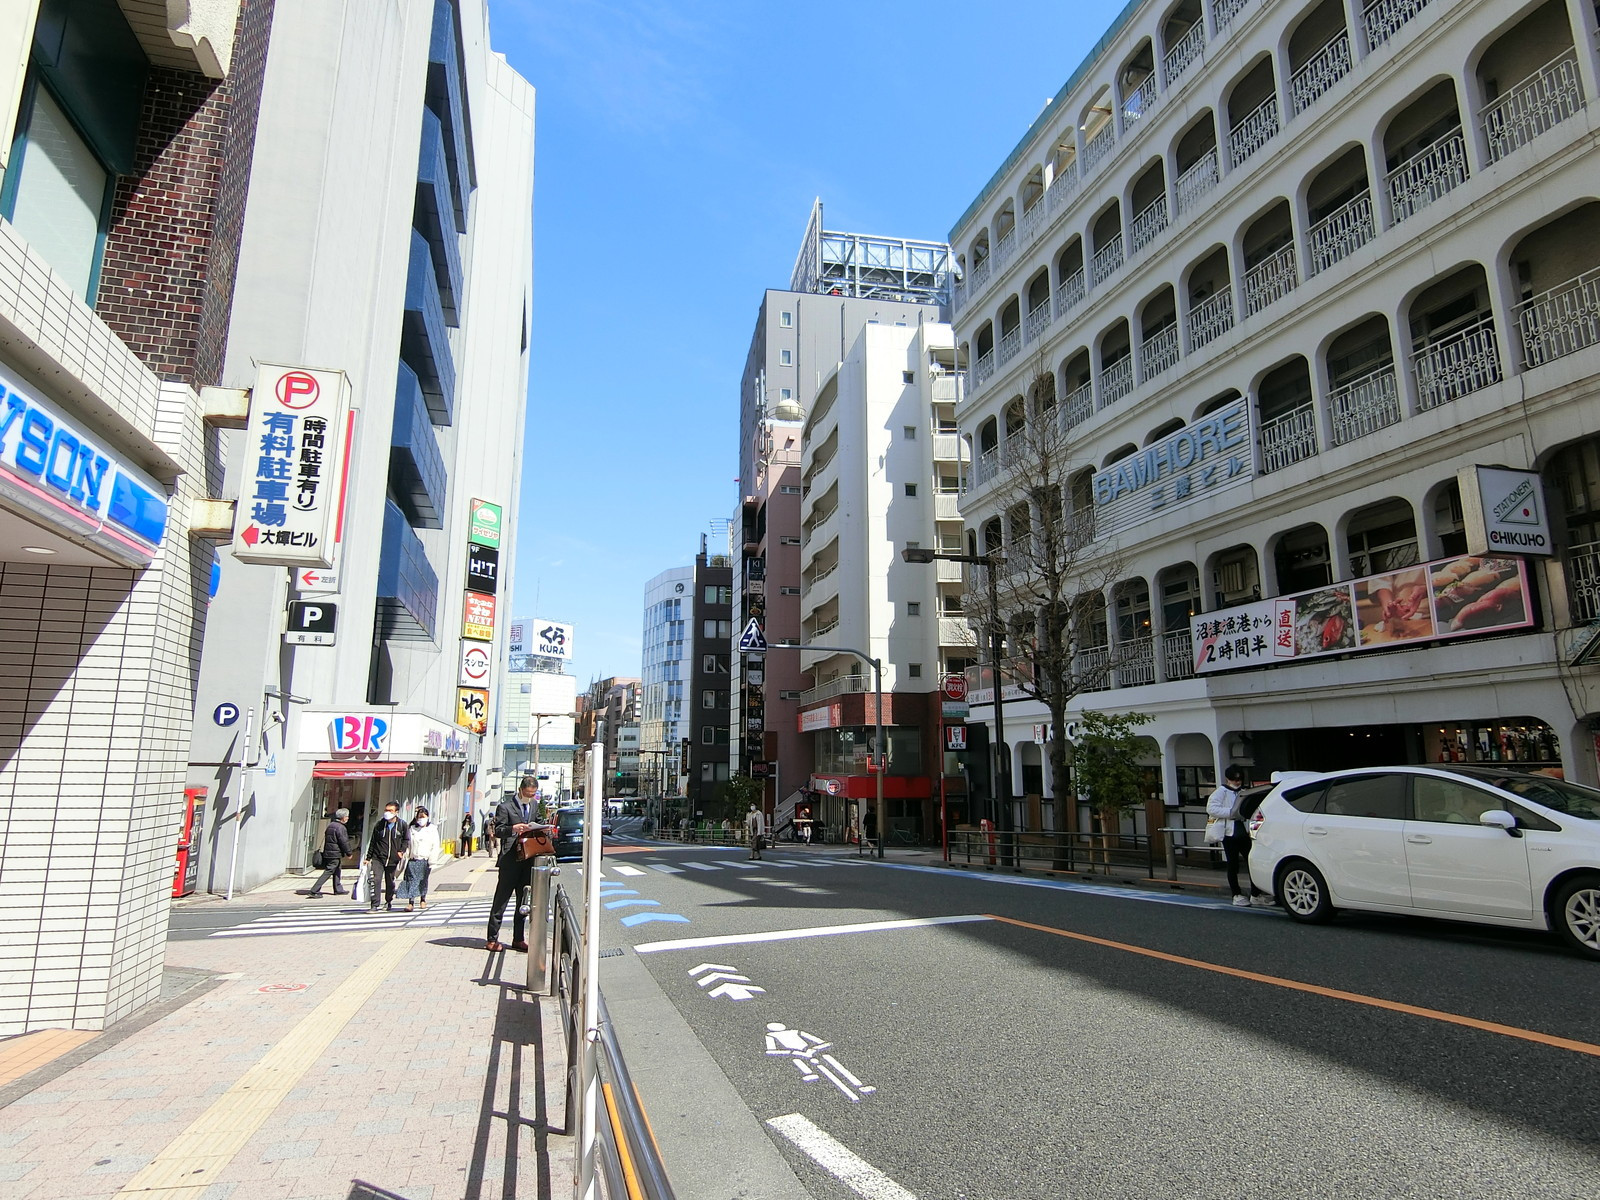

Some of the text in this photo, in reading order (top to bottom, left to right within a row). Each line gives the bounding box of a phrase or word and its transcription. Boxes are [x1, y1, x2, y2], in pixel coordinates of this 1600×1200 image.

[284, 376, 314, 403] P
[251, 411, 298, 527] 有料駐車場
[1493, 478, 1532, 517] STATIONERY
[261, 529, 317, 548] 大輝ビル
[1490, 531, 1545, 546] CHIKUHO
[303, 606, 323, 628] P
[467, 614, 493, 626] NEXT
[1196, 613, 1272, 641] 沼津漁港から
[540, 626, 565, 645] くら
[1277, 609, 1293, 648] 直送
[540, 644, 565, 655] KURA
[1206, 635, 1267, 663] 2時間半
[464, 658, 489, 668] スシロー
[220, 706, 236, 724] P
